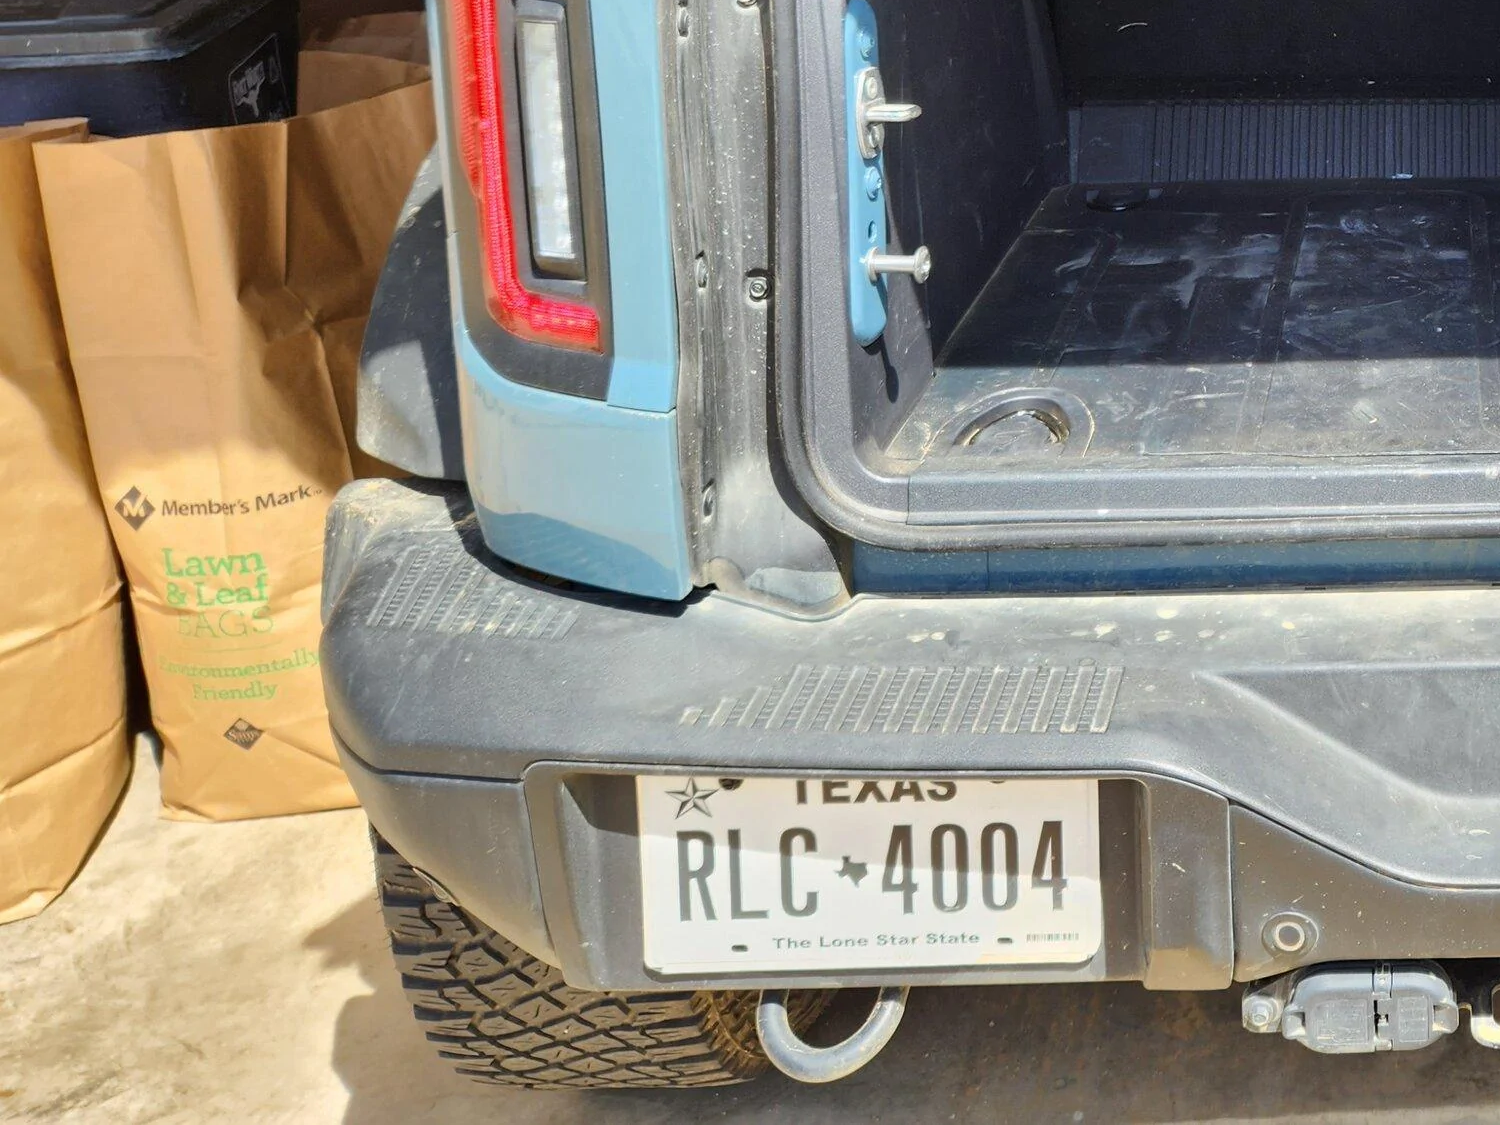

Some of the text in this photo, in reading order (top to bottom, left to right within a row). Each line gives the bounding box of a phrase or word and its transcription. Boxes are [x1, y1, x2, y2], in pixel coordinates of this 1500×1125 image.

[162, 484, 313, 517] Member's Mark
[162, 547, 269, 578] Lawn
[166, 573, 269, 607] & Leaf
[178, 605, 275, 638] BAGS
[158, 648, 320, 679] Environmentally
[193, 680, 279, 701] Friendly
[676, 819, 1070, 923] RLC 4004
[772, 931, 980, 950] The Lone Star State
